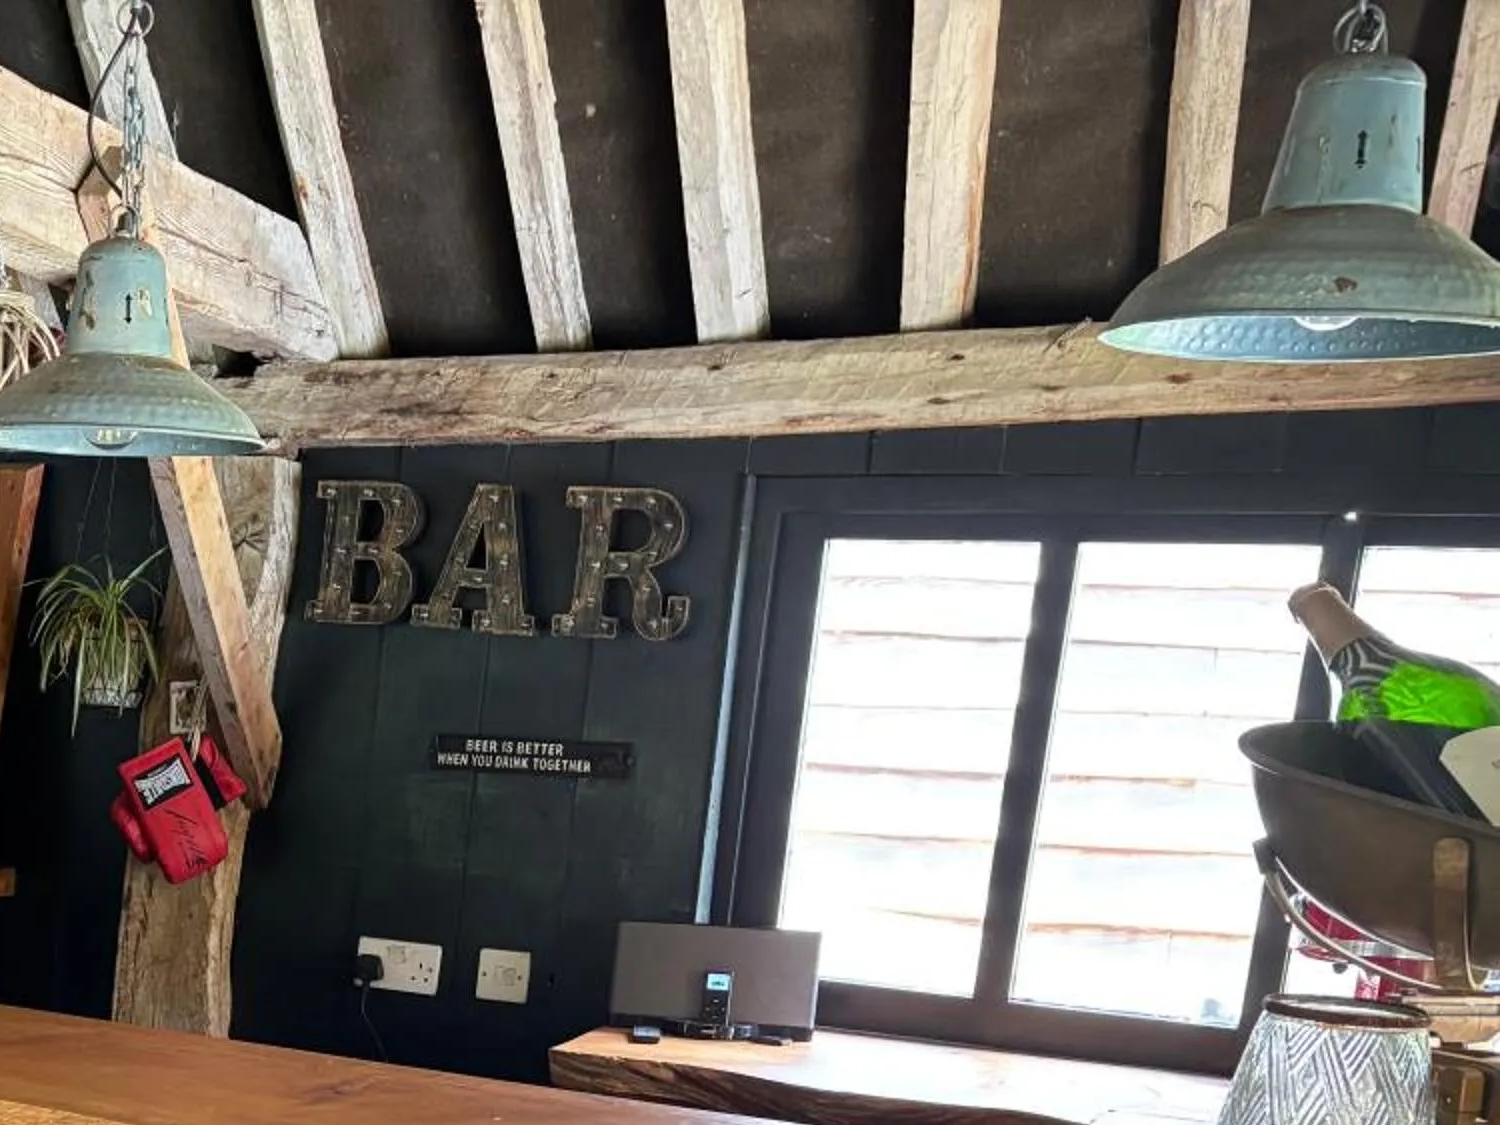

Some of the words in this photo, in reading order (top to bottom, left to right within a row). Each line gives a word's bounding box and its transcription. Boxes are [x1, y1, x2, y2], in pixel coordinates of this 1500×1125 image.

[305, 480, 691, 641] BAR
[466, 739, 497, 752] BEER
[501, 741, 514, 753] IS
[516, 742, 564, 756] BETTER
[437, 752, 469, 766] WHEN
[471, 754, 493, 767] YOU
[494, 755, 529, 769] DRINK
[532, 757, 591, 773] TOGETHER
